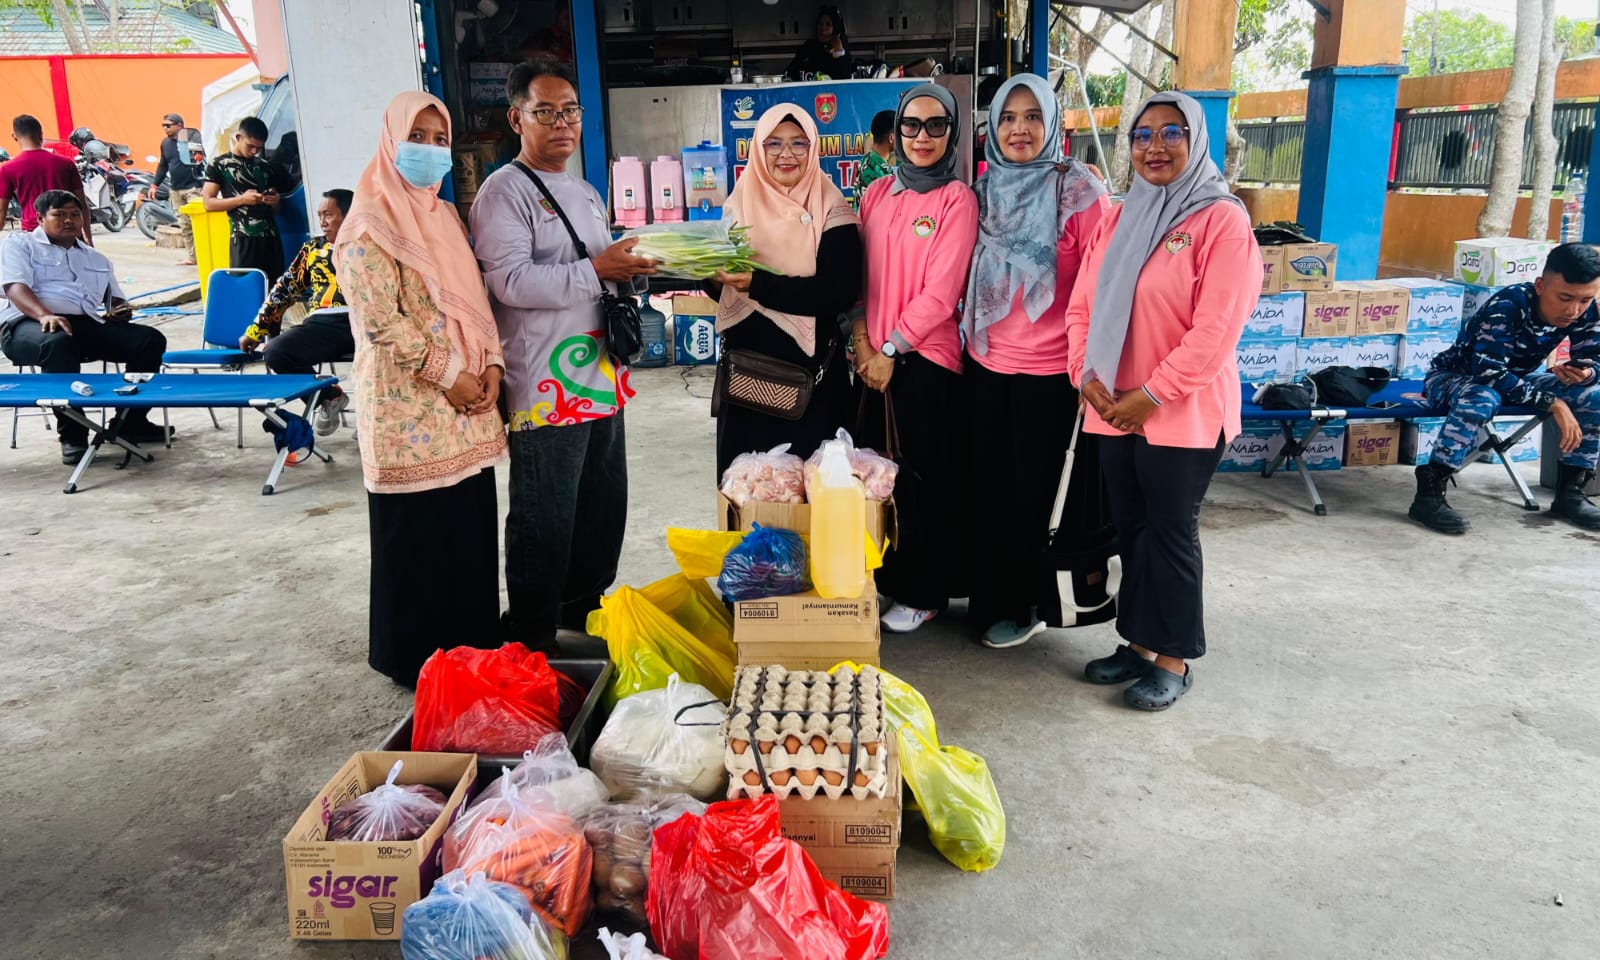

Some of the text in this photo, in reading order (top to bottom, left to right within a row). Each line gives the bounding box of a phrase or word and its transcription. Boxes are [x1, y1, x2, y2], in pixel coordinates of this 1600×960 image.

[1461, 251, 1480, 268] Dara
[1504, 260, 1538, 274] Dara
[696, 323, 710, 355] AQUA
[743, 609, 775, 617] 8109004
[850, 827, 887, 835] 8109004
[845, 878, 882, 886] 8109004
[308, 870, 398, 909] sigar.
[296, 919, 330, 929] 220ml
